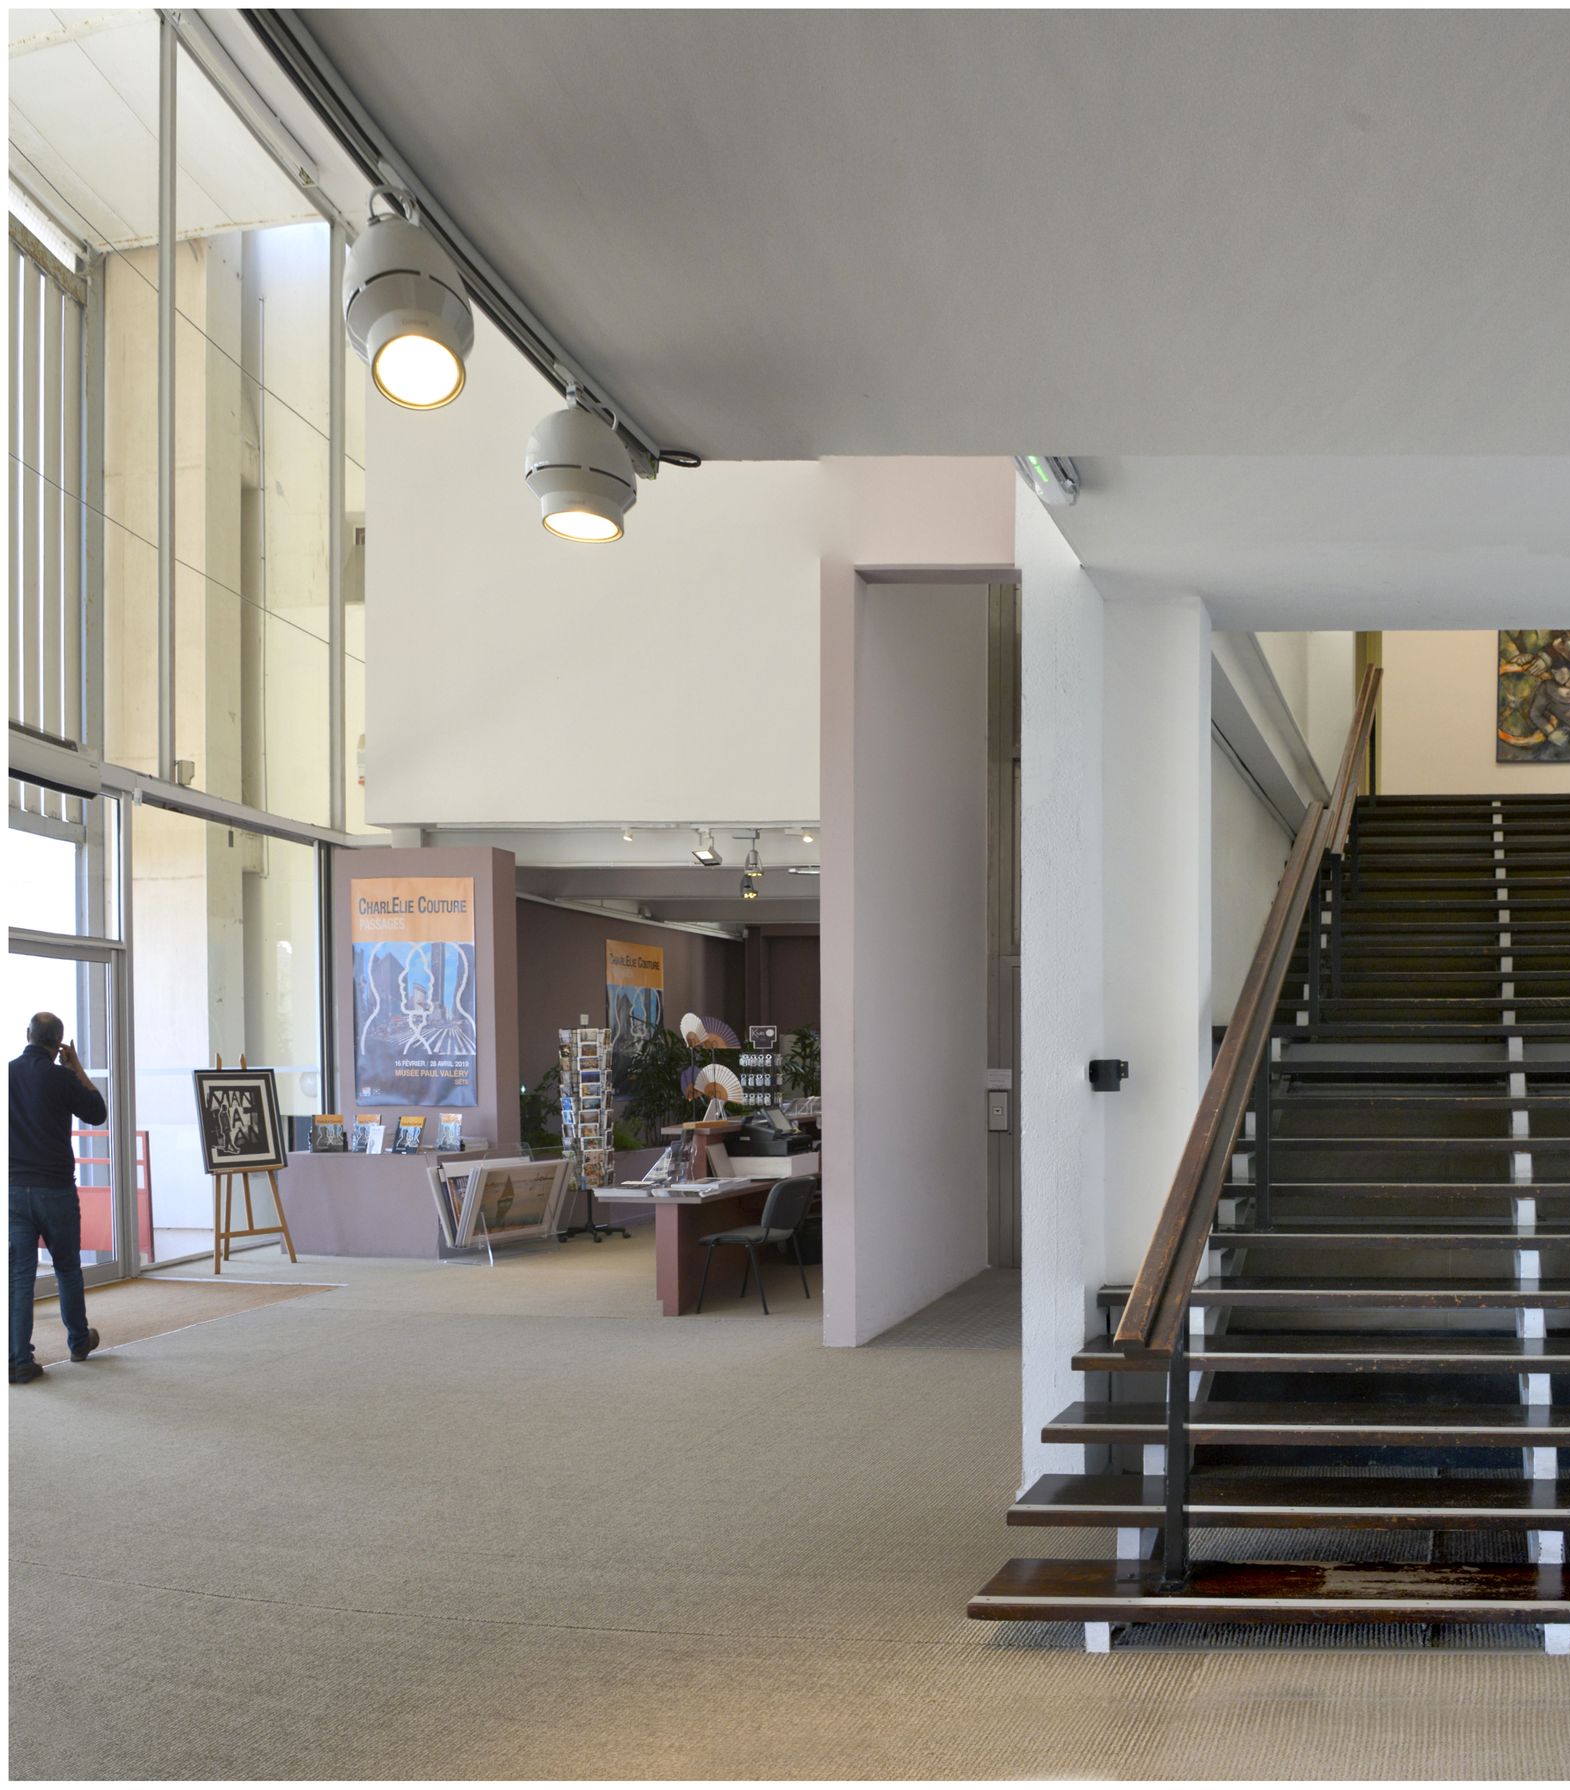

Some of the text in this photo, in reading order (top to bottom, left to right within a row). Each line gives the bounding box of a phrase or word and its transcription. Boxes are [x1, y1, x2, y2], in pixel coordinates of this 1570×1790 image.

[417, 896, 467, 913] COUTURE
[360, 918, 406, 930] PASSAGES
[437, 1060, 454, 1068] AVRIL
[395, 1068, 469, 1078] MUSÉE PAUL VALÉRY
[207, 1090, 256, 1111] MAN
